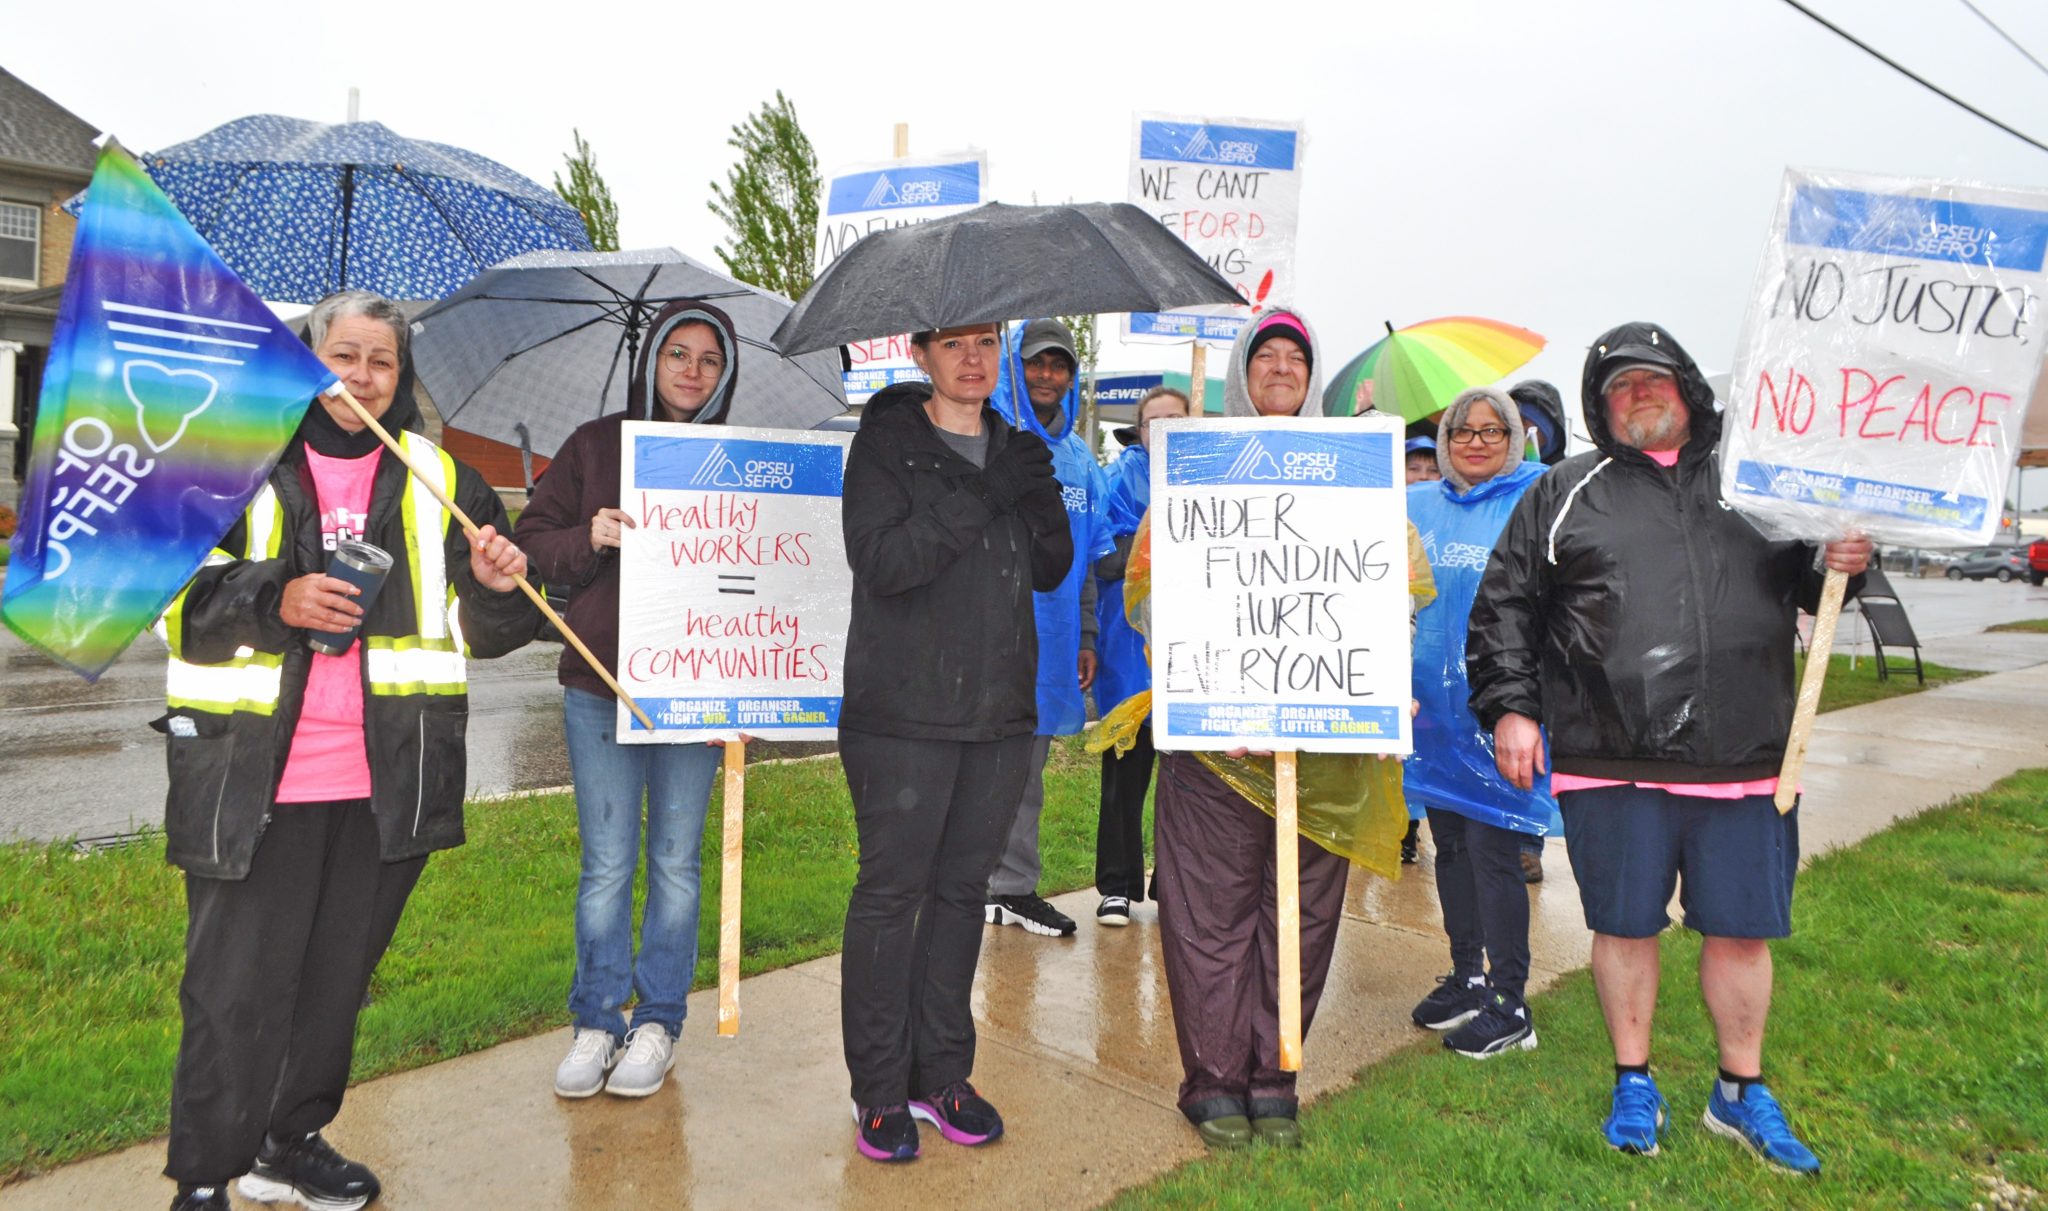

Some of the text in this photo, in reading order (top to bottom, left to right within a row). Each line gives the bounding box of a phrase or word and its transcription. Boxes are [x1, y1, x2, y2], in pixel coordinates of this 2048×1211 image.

[1220, 141, 1258, 153] OPSEU
[1219, 152, 1256, 163] SEFPO
[902, 181, 942, 193] OPSEU
[1141, 167, 1270, 200] WE CANT
[901, 192, 939, 204] SEFPO
[1920, 223, 1984, 243] OPSEU
[1914, 238, 1978, 258] SEFPO
[1771, 259, 1844, 321] NO
[1751, 367, 2011, 447] NO PEACE
[745, 460, 794, 475] OPSEU
[1283, 451, 1337, 467] OPSEU
[744, 474, 792, 489] SEFPO
[1282, 466, 1336, 481] SEFPO
[643, 491, 758, 533] healthy
[1167, 492, 1309, 543] UNDER
[672, 532, 812, 567] WORKERS
[1206, 539, 1389, 588] FUNDING
[1438, 554, 1488, 572] SEFPO
[1236, 592, 1345, 642] HURTS
[687, 606, 798, 648] healthy
[628, 644, 828, 682] COMMUNITIES
[670, 700, 803, 712] ORGANIZE. ORGANISER.
[1281, 707, 1353, 720] ORGANISER.
[663, 712, 829, 724] FIGHT. WIN. LUTTER. GAGNER.
[1281, 720, 1328, 733] LUTTER.
[1330, 721, 1384, 735] GAGNER.
